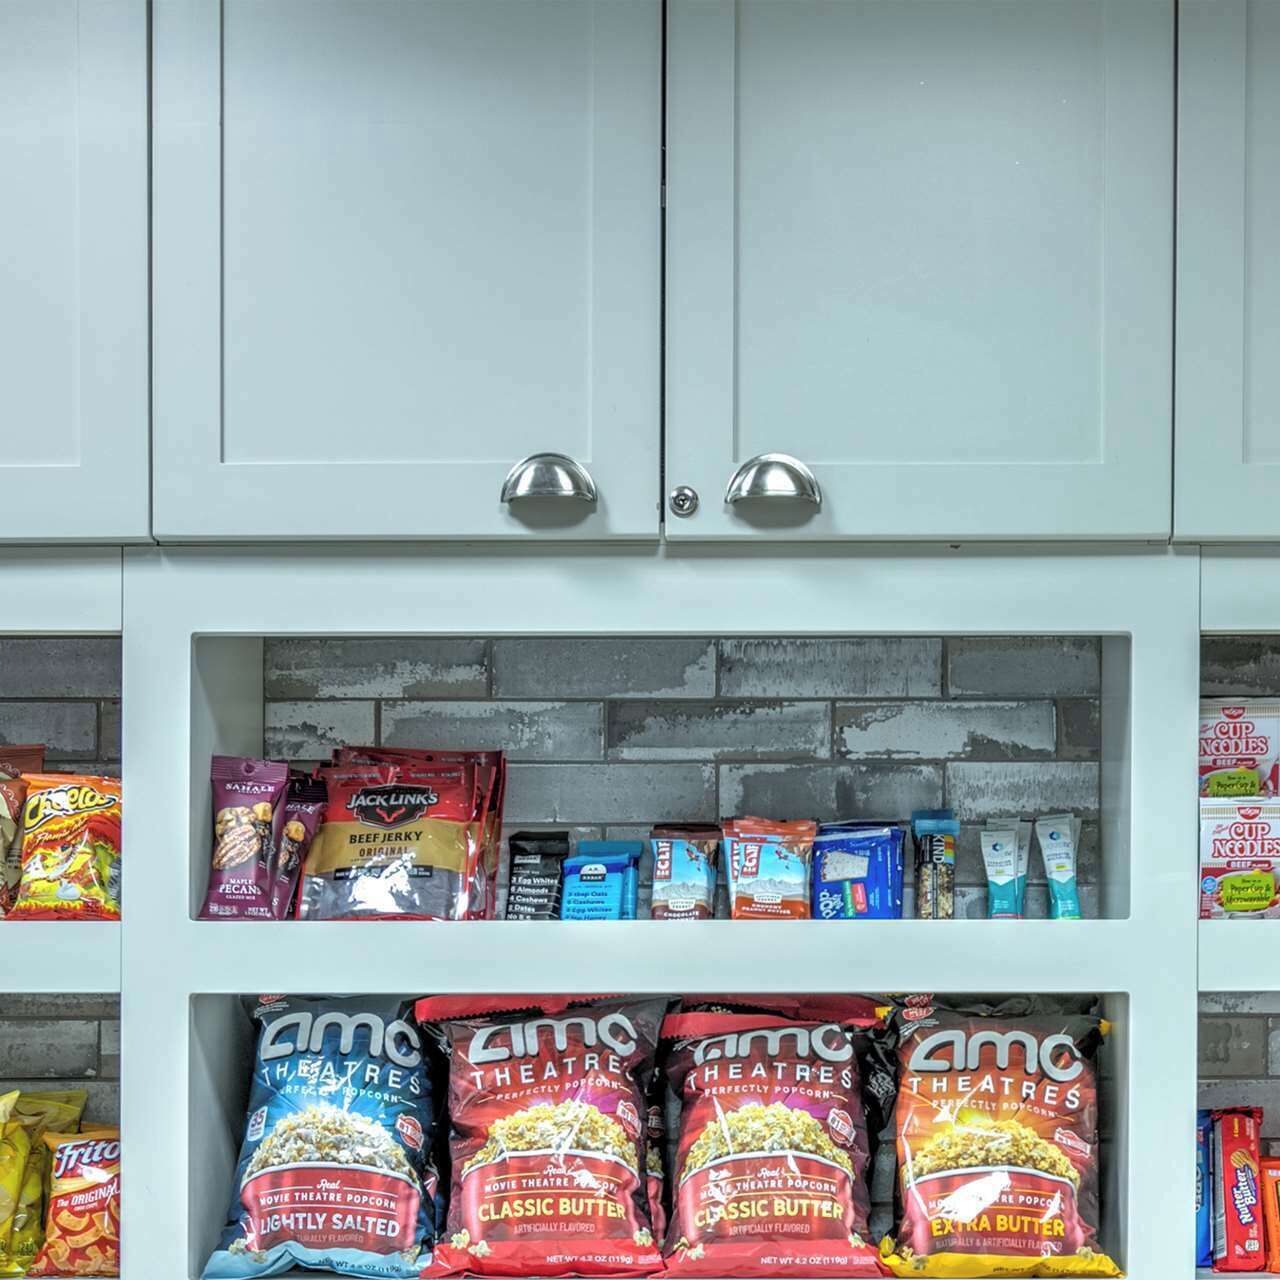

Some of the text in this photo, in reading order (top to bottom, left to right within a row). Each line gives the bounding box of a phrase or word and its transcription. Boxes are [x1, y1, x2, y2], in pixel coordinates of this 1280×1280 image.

[1215, 721, 1255, 739] CUP
[1199, 736, 1269, 756] NOODLES
[1216, 758, 1237, 766] BEEF
[225, 783, 275, 793] SAHALE
[347, 793, 439, 809] JACK LINK'S
[349, 831, 424, 844] BEEF JERKY
[1229, 822, 1271, 840] CUP
[359, 846, 409, 857] ORIGINAL
[933, 834, 944, 863] KIND
[1230, 860, 1252, 868] BEEF
[518, 876, 559, 885] Egg Whites
[514, 904, 535, 913] Dates
[515, 896, 548, 904] Cashews
[260, 1011, 421, 1067] amc
[468, 1012, 638, 1064] amc
[693, 1025, 854, 1066] amc
[908, 1029, 1083, 1082] amc
[262, 1060, 421, 1094] THEATRES
[687, 1061, 852, 1090] THEATRES
[496, 1076, 620, 1100] PERFECTLY POPCORN
[704, 1084, 833, 1099] PERFECTLY POPCORN
[909, 1074, 1080, 1109] THEATRES
[1002, 1101, 1057, 1118] POPCORN
[55, 1139, 120, 1179] Frito
[317, 1178, 341, 1190] Real
[485, 1177, 568, 1193] MOVIE THEATRE
[736, 1179, 837, 1194] THEATRE POPCORN
[260, 1192, 396, 1210] MOVIE THEATRE POPCORN
[1233, 1169, 1257, 1224] Nutter Butter
[478, 1198, 627, 1222] CLASSIC BUTTER
[694, 1199, 844, 1228] CLASSIC BUTTER
[260, 1212, 400, 1238] LIGHTLY SALTED
[559, 1222, 596, 1233] FLAVORED
[774, 1222, 810, 1234] FLAVORED
[931, 1214, 1065, 1237] EXTRA BUTTER
[546, 1255, 564, 1263] NET
[594, 1255, 608, 1263] OZ
[760, 1256, 777, 1264] NET
[779, 1256, 793, 1264] WT
[808, 1256, 821, 1264] OZ
